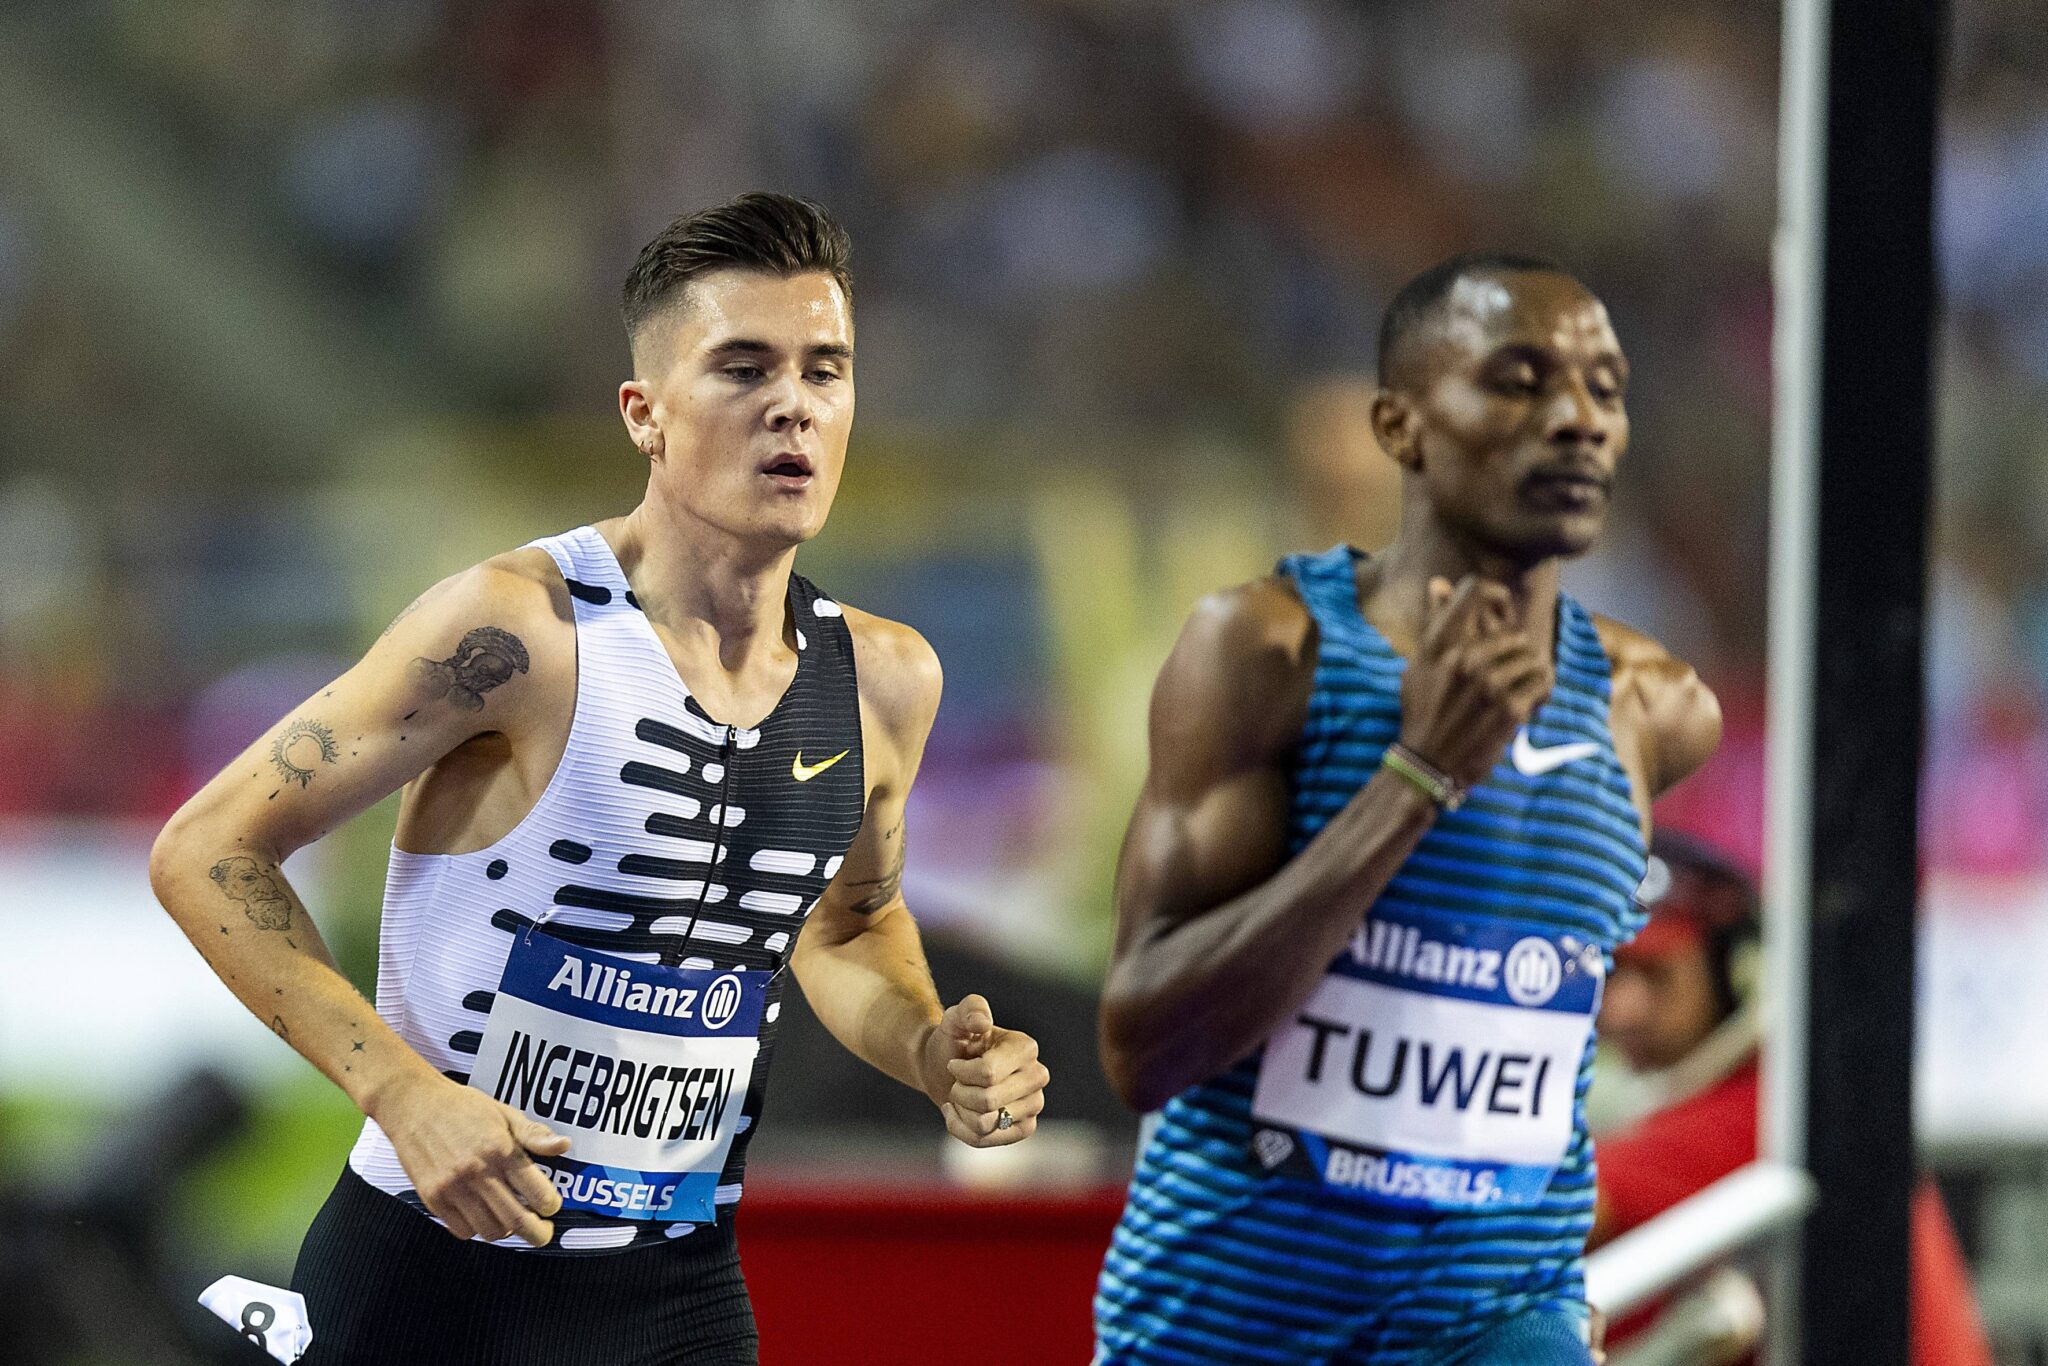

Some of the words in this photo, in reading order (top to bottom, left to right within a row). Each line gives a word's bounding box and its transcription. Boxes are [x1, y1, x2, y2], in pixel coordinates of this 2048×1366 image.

[548, 955, 698, 1018] Allianz
[494, 1030, 735, 1141] INGEBRIGTSEN
[1297, 1014, 1551, 1118] TUWEI
